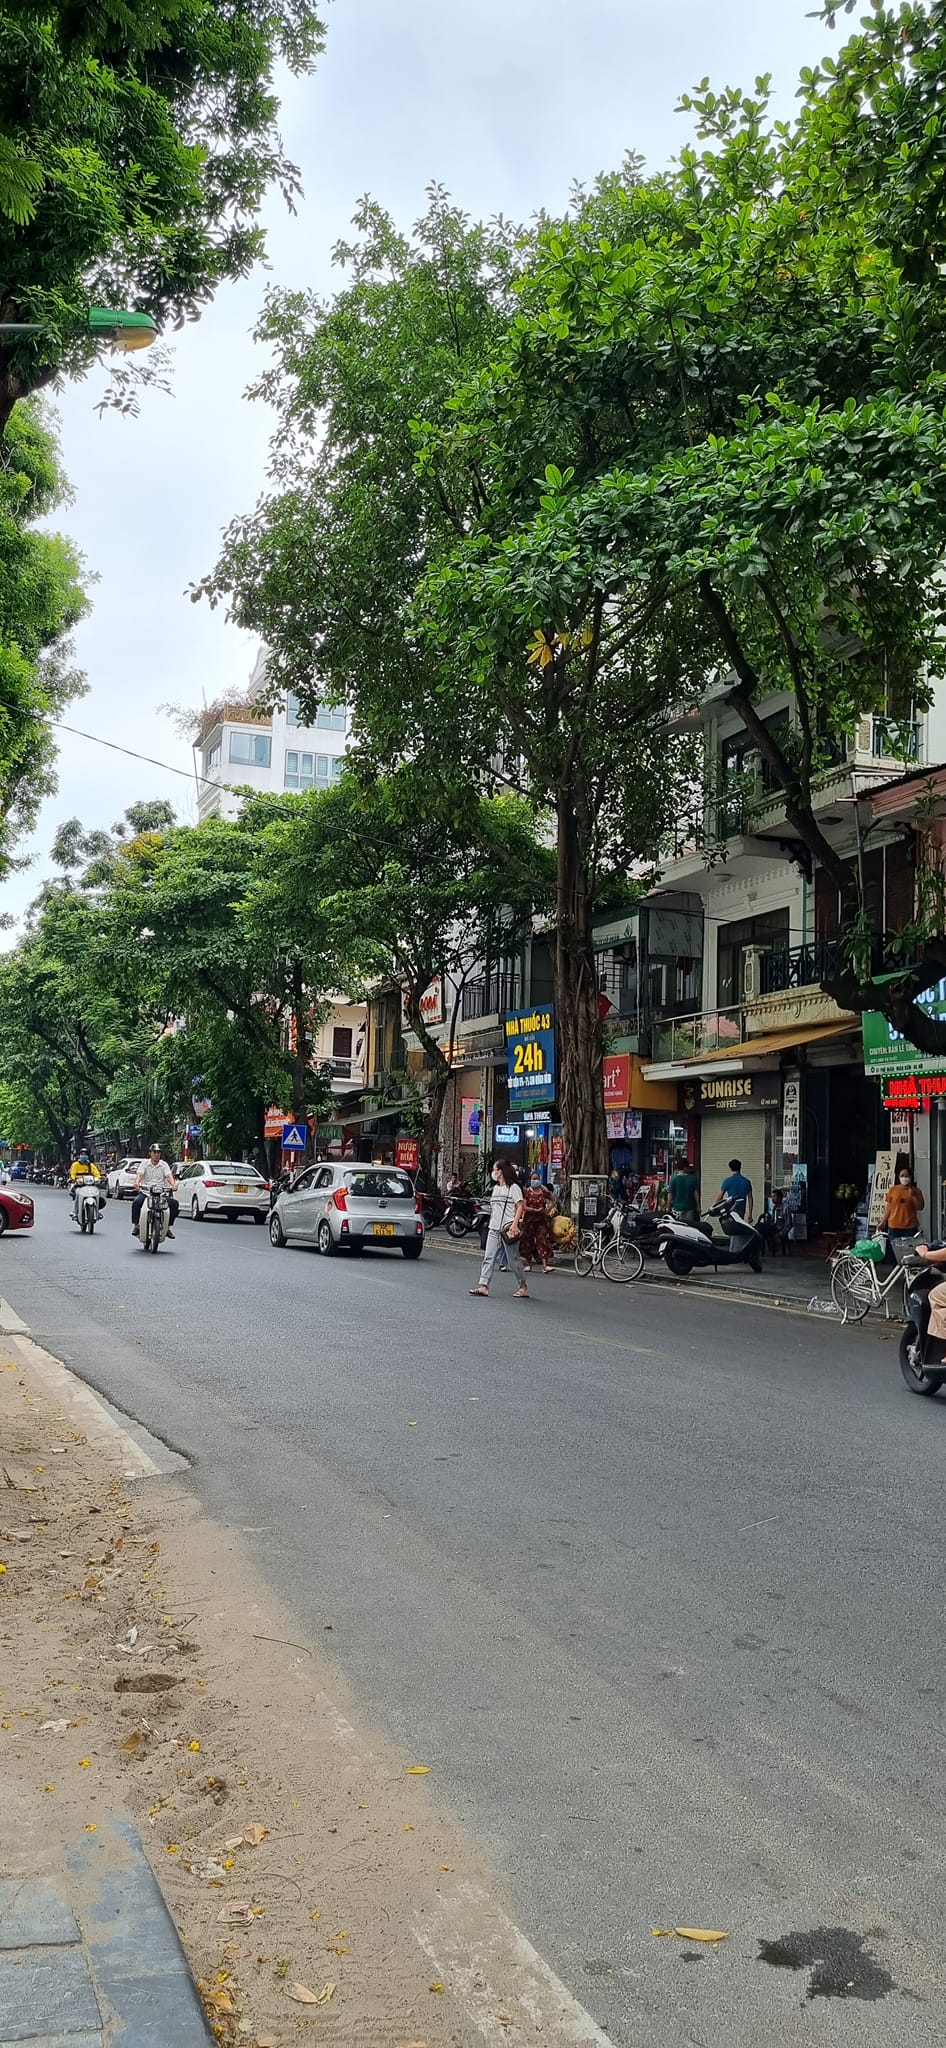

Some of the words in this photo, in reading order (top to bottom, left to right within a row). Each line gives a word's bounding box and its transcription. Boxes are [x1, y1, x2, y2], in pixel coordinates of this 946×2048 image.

[505, 1016, 519, 1036] NHÀ
[520, 1010, 540, 1034] THUỐC
[541, 1013, 551, 1030] 43
[513, 1042, 543, 1074] 24h
[701, 1079, 751, 1099] SUNRISE
[889, 1075, 918, 1096] NHÀ
[716, 1100, 737, 1109] COFFEE
[398, 1141, 417, 1151] NƯỚC
[400, 1151, 414, 1161] MÍA
